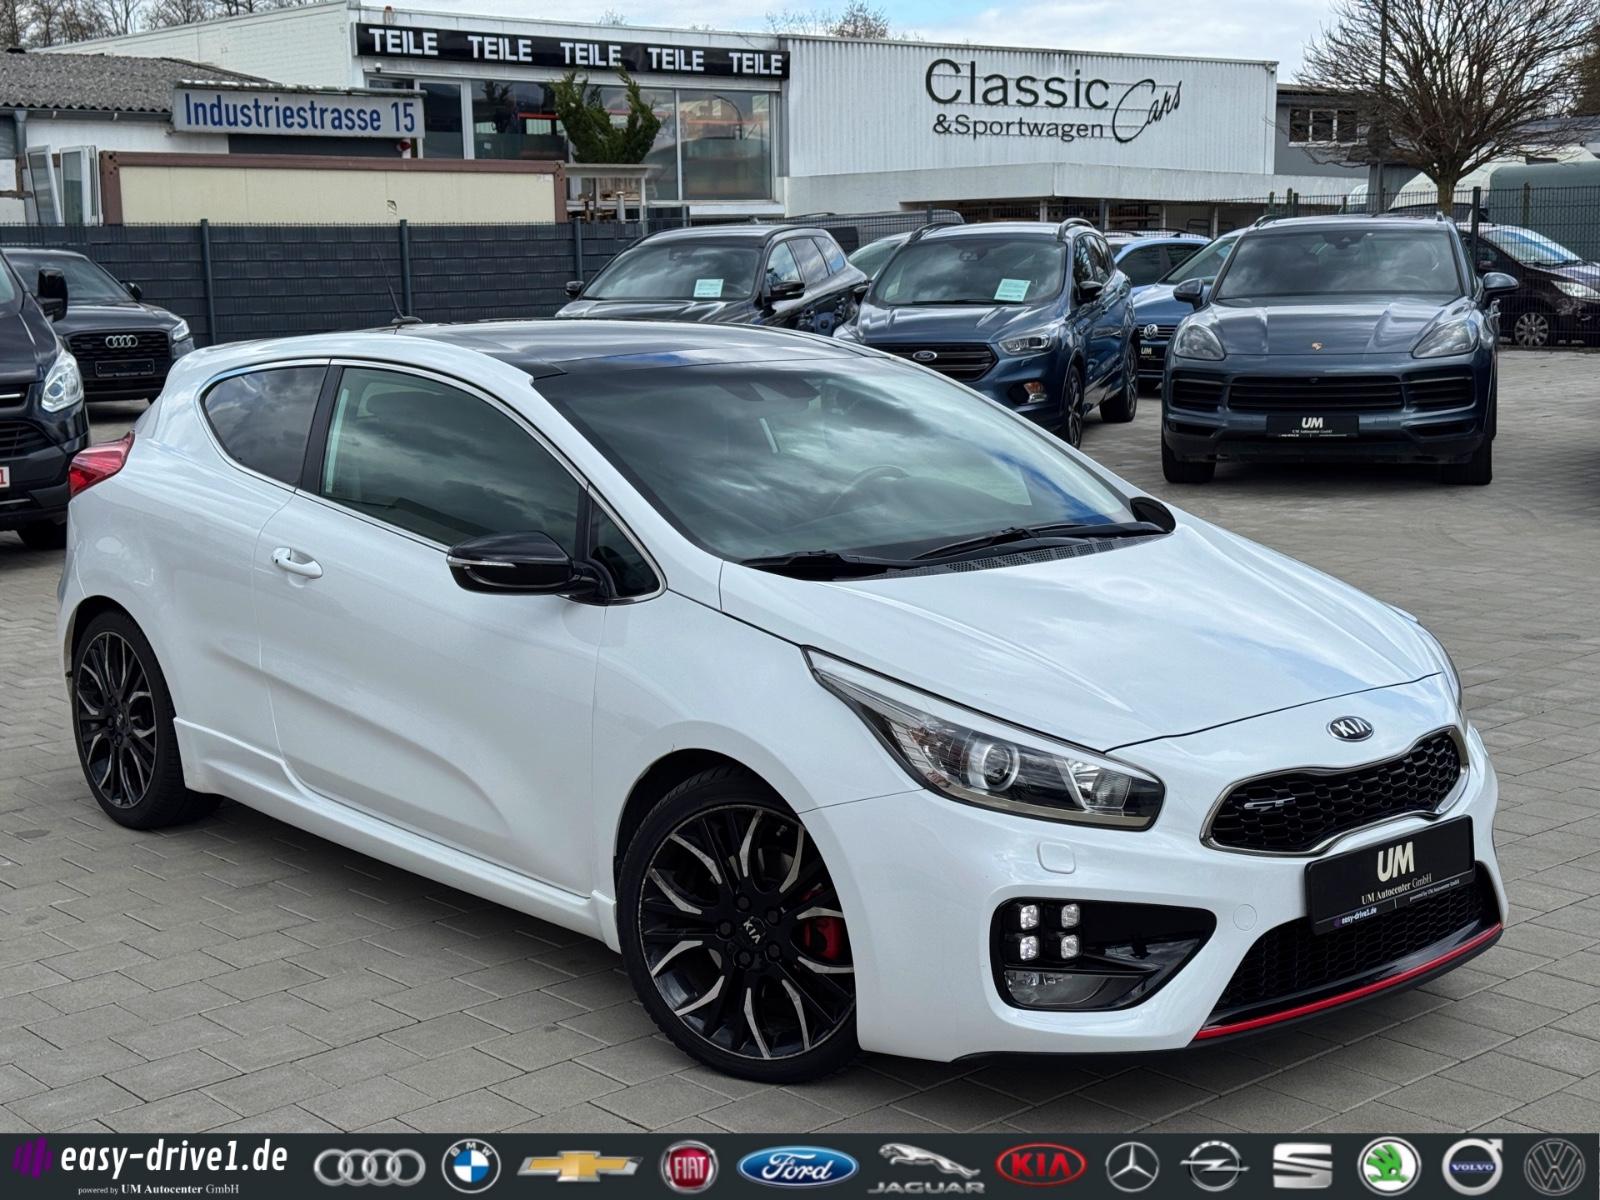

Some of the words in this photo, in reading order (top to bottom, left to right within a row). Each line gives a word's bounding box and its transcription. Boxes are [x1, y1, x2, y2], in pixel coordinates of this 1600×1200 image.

[368, 28, 439, 56] TEILE
[467, 35, 533, 62] TEILE
[560, 42, 622, 67] TEILE
[647, 47, 705, 72] TEILE
[729, 52, 783, 75] TEILE
[925, 58, 1111, 110] Classic
[185, 93, 381, 132] Industriestrasse
[391, 102, 415, 132] 15
[932, 113, 1104, 143] &Sportwagen
[1112, 79, 1182, 144] Cars
[1301, 417, 1323, 429] UM
[1377, 841, 1415, 882] UM
[1361, 893, 1376, 905] UM
[1377, 882, 1411, 900] Autocenter
[1411, 873, 1432, 888] GmbH
[743, 919, 761, 944] KIA
